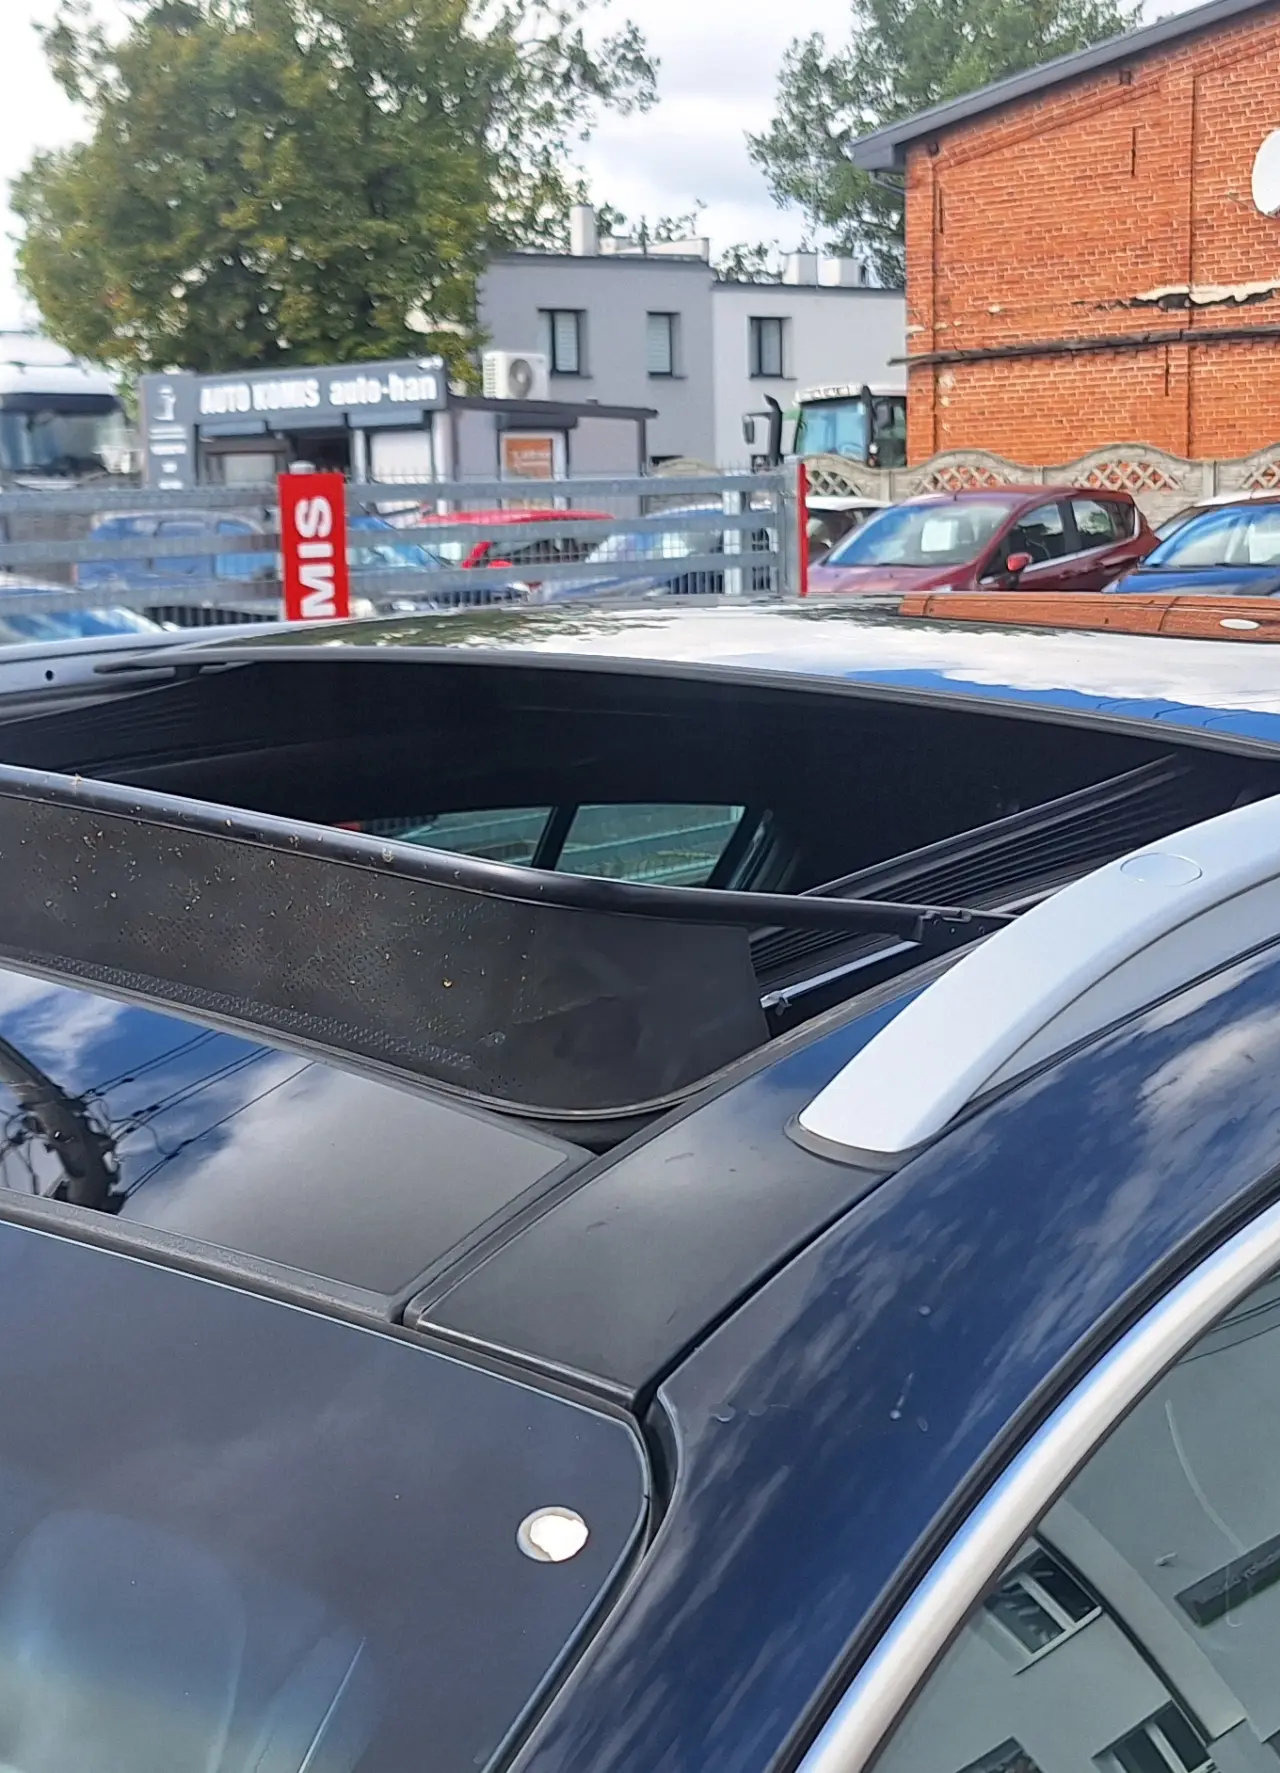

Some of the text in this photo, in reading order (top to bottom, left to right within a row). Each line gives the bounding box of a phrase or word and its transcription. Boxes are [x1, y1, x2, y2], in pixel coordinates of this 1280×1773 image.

[200, 372, 438, 415] AUTO KOMIS auto-han
[294, 496, 337, 617] MIS
